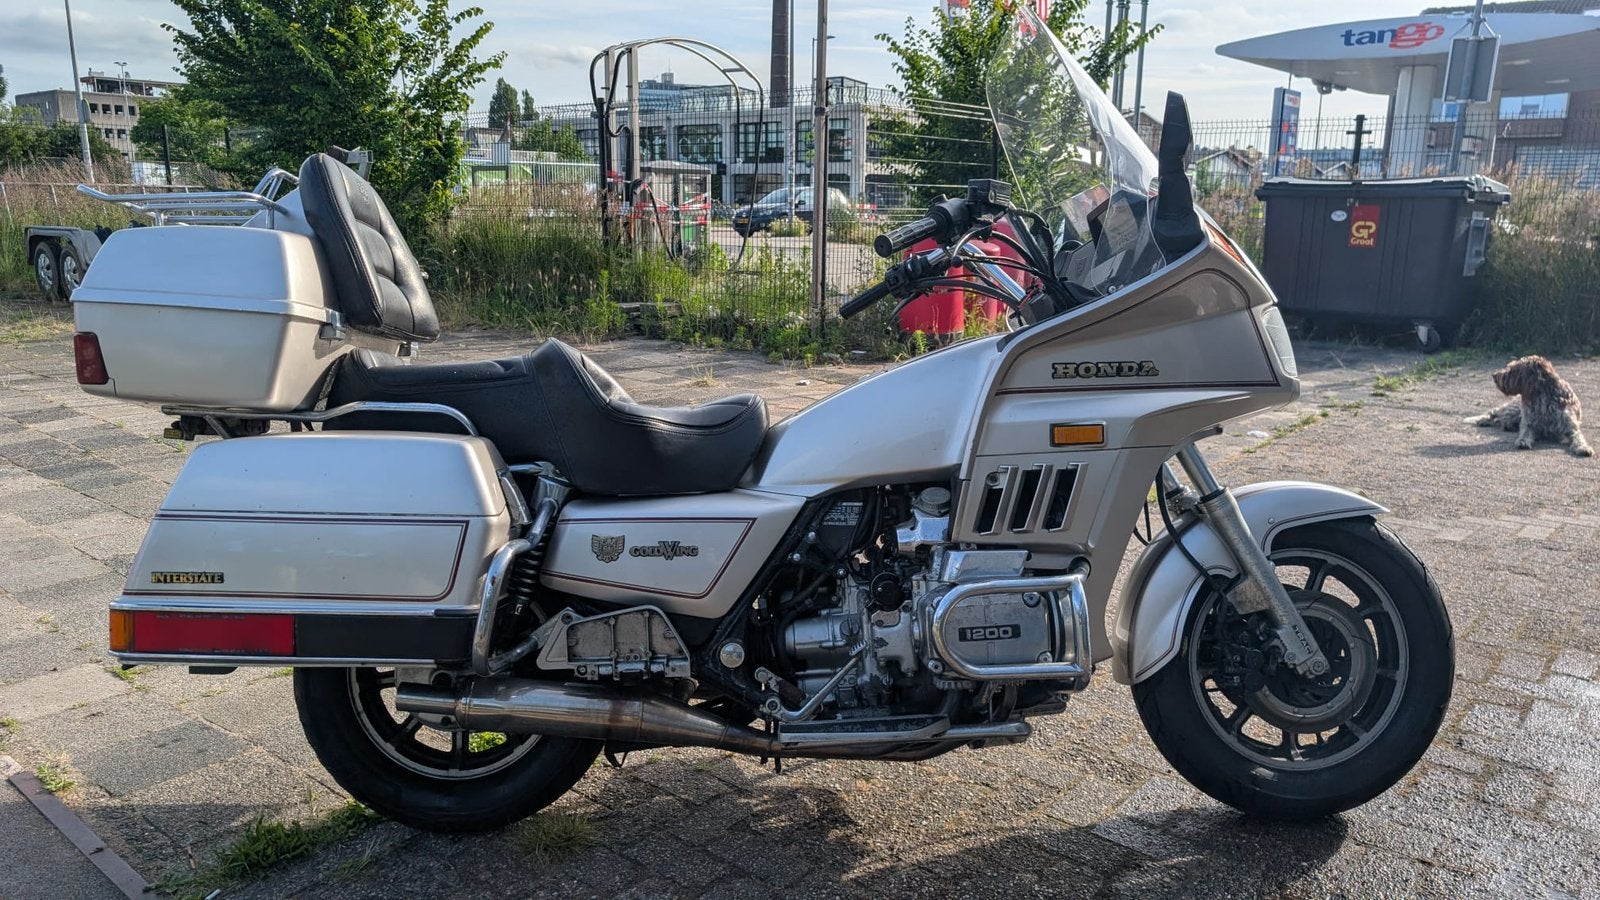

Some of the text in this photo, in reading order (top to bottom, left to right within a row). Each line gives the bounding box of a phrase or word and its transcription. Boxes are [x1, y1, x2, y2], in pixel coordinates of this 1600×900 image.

[1340, 22, 1444, 49] tango
[1350, 237, 1374, 246] Groot
[1052, 361, 1159, 379] HONDA
[151, 572, 223, 584] INTERSTATE
[965, 626, 1012, 640] 1200
